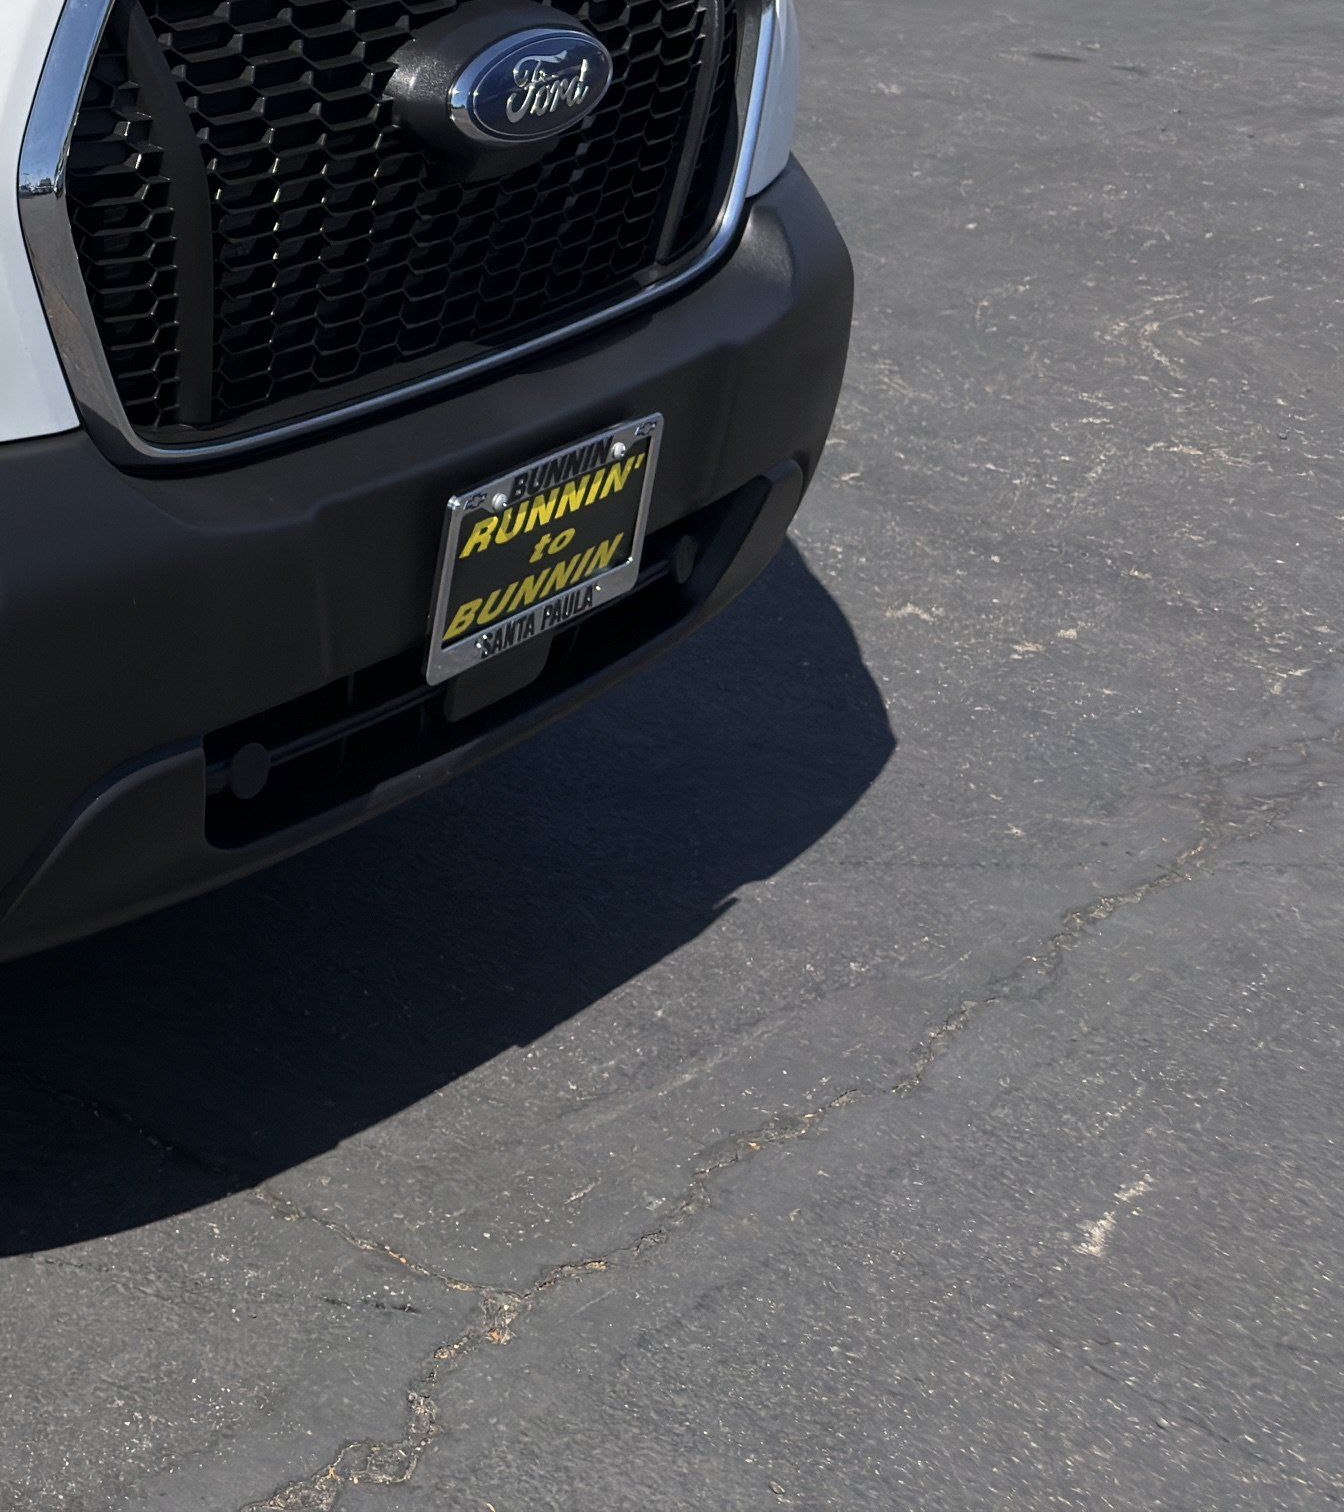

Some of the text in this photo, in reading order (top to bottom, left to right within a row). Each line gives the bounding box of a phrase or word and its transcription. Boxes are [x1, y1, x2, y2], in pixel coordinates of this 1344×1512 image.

[506, 49, 590, 123] Ford
[510, 435, 615, 498] BUNNIN
[459, 452, 646, 559] RUNNIN'
[528, 527, 576, 564] to
[442, 532, 624, 642] BUNNIN
[480, 584, 593, 660] SANTA PAULA
